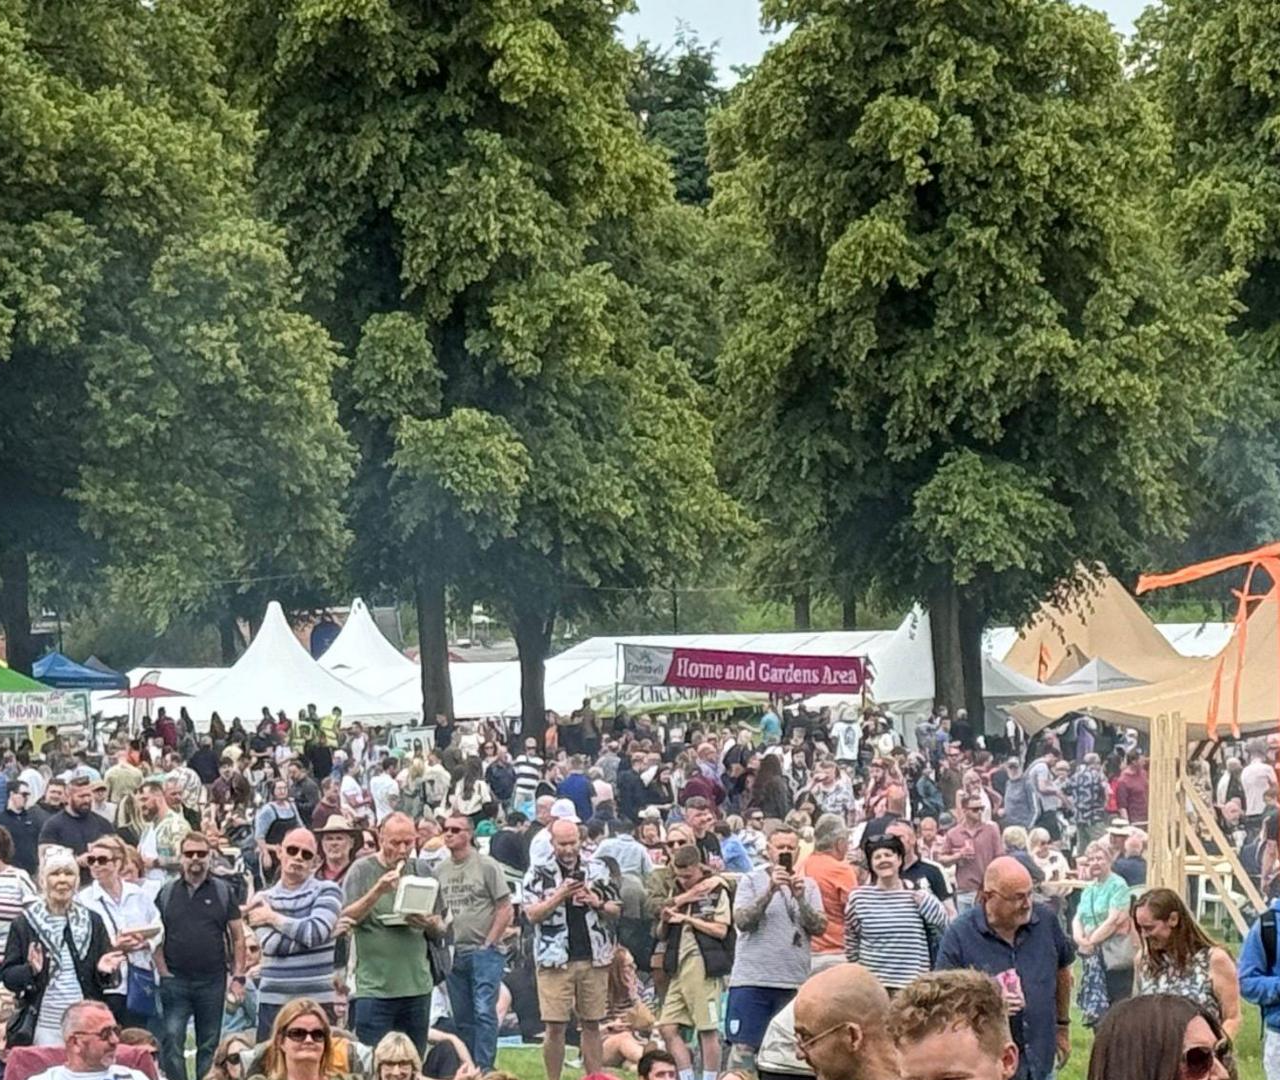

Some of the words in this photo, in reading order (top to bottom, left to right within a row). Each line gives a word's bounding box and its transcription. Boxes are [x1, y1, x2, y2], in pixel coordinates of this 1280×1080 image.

[676, 657, 723, 679] Home
[724, 660, 756, 682] and
[758, 662, 820, 684] Gardens
[821, 664, 858, 685] Area
